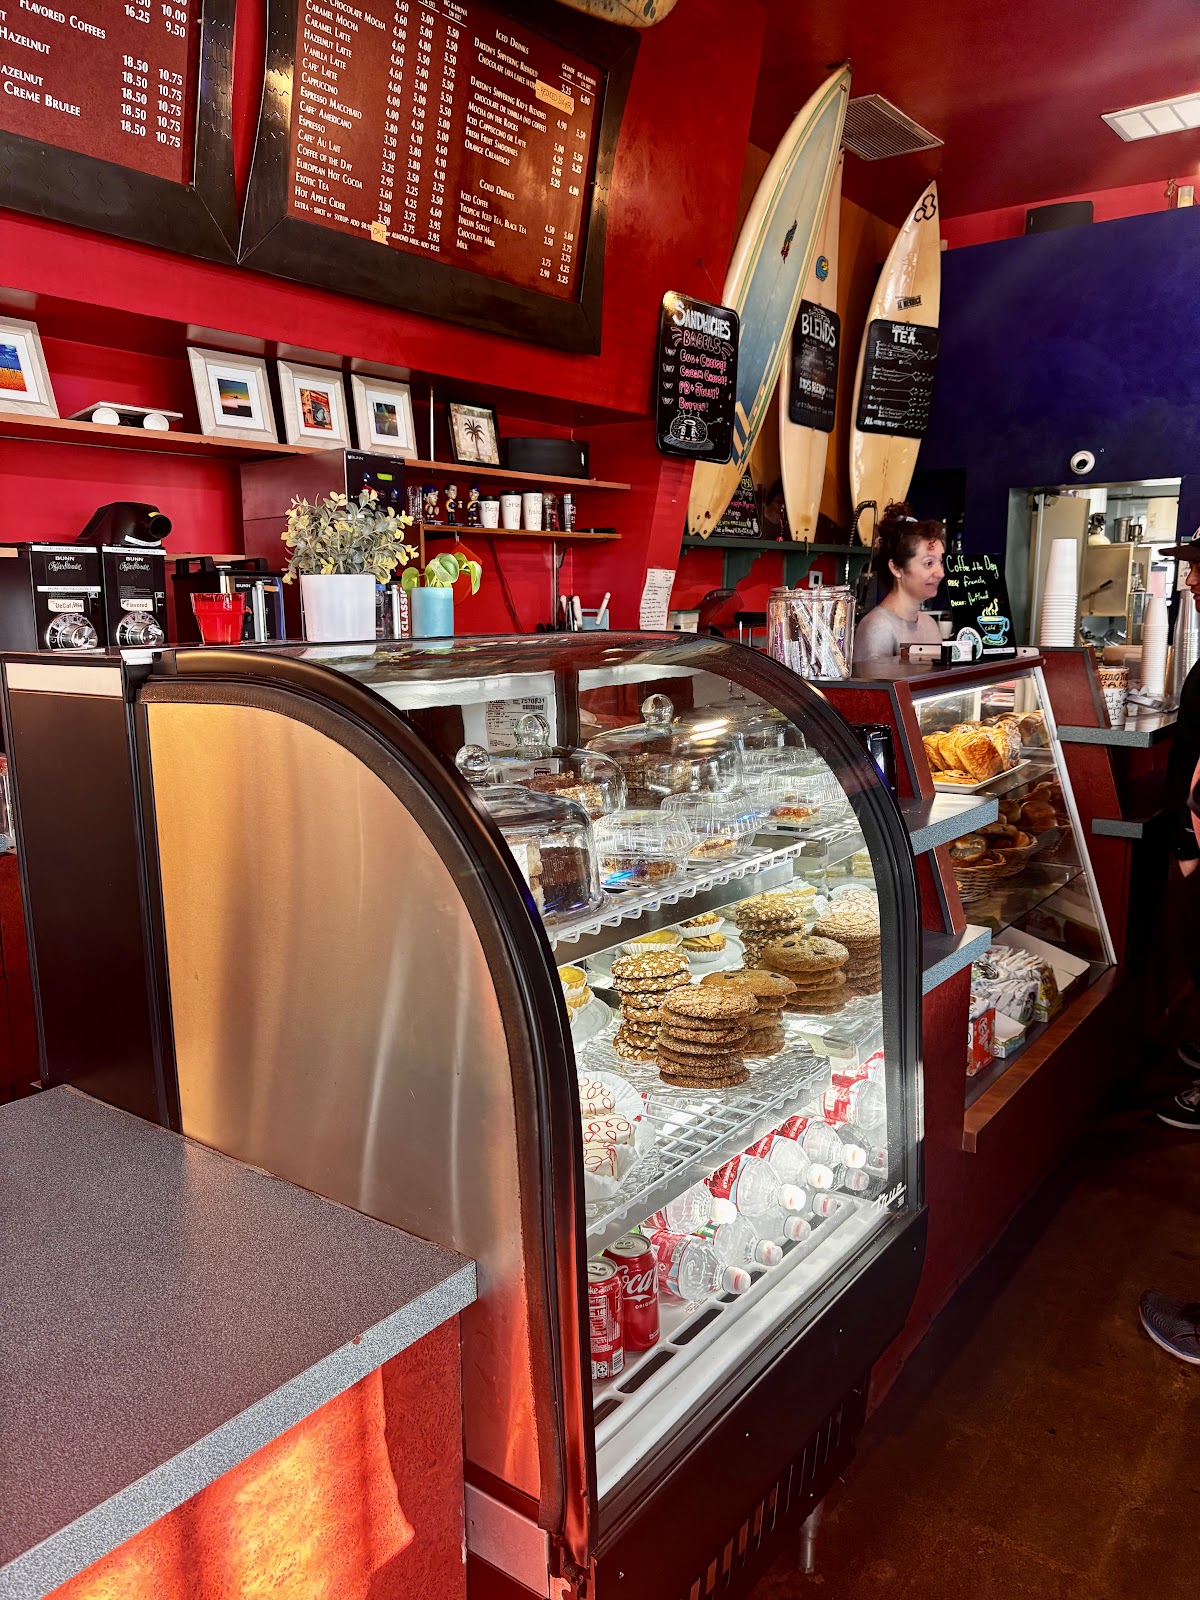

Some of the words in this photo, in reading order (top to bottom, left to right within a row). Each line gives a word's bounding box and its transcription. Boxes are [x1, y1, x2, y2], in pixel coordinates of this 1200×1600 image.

[19, 0, 66, 24] FLAVORED
[69, 15, 106, 40] COFFEES
[124, 4, 151, 24] 16.25
[161, 4, 187, 24] 10.00
[306, 0, 333, 20] CARAMEL
[335, 13, 359, 32] MOCHA
[364, 12, 387, 31] MOCHA
[0, 25, 51, 54] HAZELNUT
[165, 21, 186, 38] 9.50
[305, 14, 333, 35] CARAMEL
[335, 27, 352, 43] LATTE
[303, 42, 328, 62] VANILLA
[330, 54, 347, 70] LATTE
[304, 28, 334, 50] HAZELNUT
[336, 42, 352, 58] LATTE
[122, 55, 149, 73] 18.50
[158, 68, 183, 86] 10.75
[301, 72, 338, 95] CAPPUCCINO
[321, 65, 338, 81] LATTE
[3, 80, 41, 104] CREME
[44, 93, 81, 117] BRULEE
[121, 71, 148, 89] 18.50
[157, 84, 182, 102] 10.75
[121, 87, 148, 105] 18.50
[157, 100, 181, 117] 10.75
[300, 85, 327, 105] ESPRESSO
[329, 98, 362, 119] MACCHIATO
[474, 92, 499, 110] CHOCOLATE
[120, 103, 147, 121] 18.50
[156, 115, 181, 132] 10.75
[298, 115, 326, 133] ESPRESSO
[319, 108, 352, 129] AMERICANO
[466, 113, 478, 126] ICED
[468, 101, 487, 117] MOCHA
[503, 117, 519, 132] ROCKS
[120, 120, 146, 137] 18.50
[155, 131, 181, 148] 10.75
[317, 137, 327, 148] AU
[329, 140, 341, 153] LAIT
[465, 126, 480, 140] FRESH
[297, 143, 319, 159] COFFEE
[319, 153, 327, 162] OF
[328, 156, 339, 167] THE
[340, 159, 353, 171] DAY
[296, 157, 326, 176] EUROPEAN
[328, 168, 340, 181] HOT
[342, 173, 363, 190] COCOA
[296, 171, 316, 187] EXOTIC
[318, 178, 330, 191] TEA
[295, 185, 308, 199] HOT
[310, 191, 327, 205] APPLE
[329, 197, 346, 211] CIDER
[460, 190, 472, 202] ICED
[472, 195, 489, 209] COFFEE
[457, 226, 483, 243] CHOCOLATE
[672, 299, 731, 341] SANDWICHES
[801, 312, 836, 349] BLENDS
[682, 330, 721, 355] BAGELS
